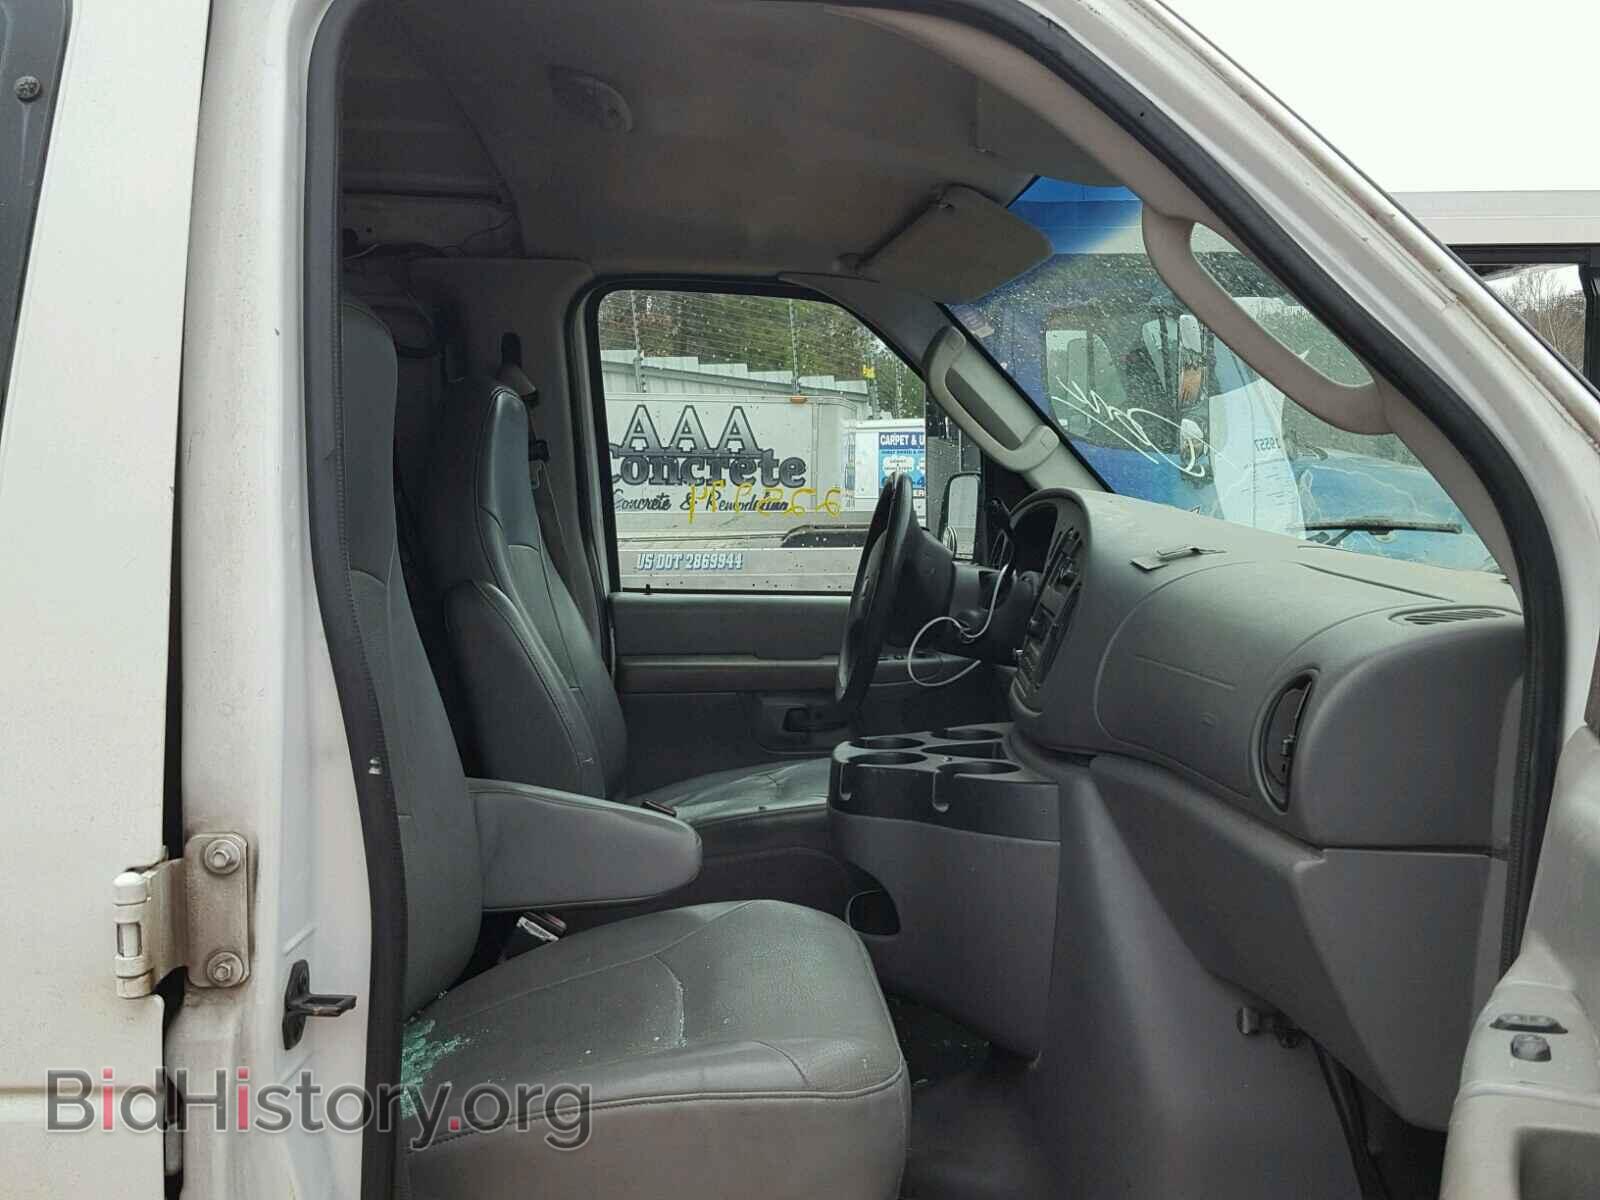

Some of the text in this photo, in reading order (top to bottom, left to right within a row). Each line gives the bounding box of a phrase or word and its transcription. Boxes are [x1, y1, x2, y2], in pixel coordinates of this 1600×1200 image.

[616, 404, 764, 456] AAA
[880, 434, 909, 447] CARPET
[638, 553, 655, 570] US
[655, 553, 684, 570] DOT
